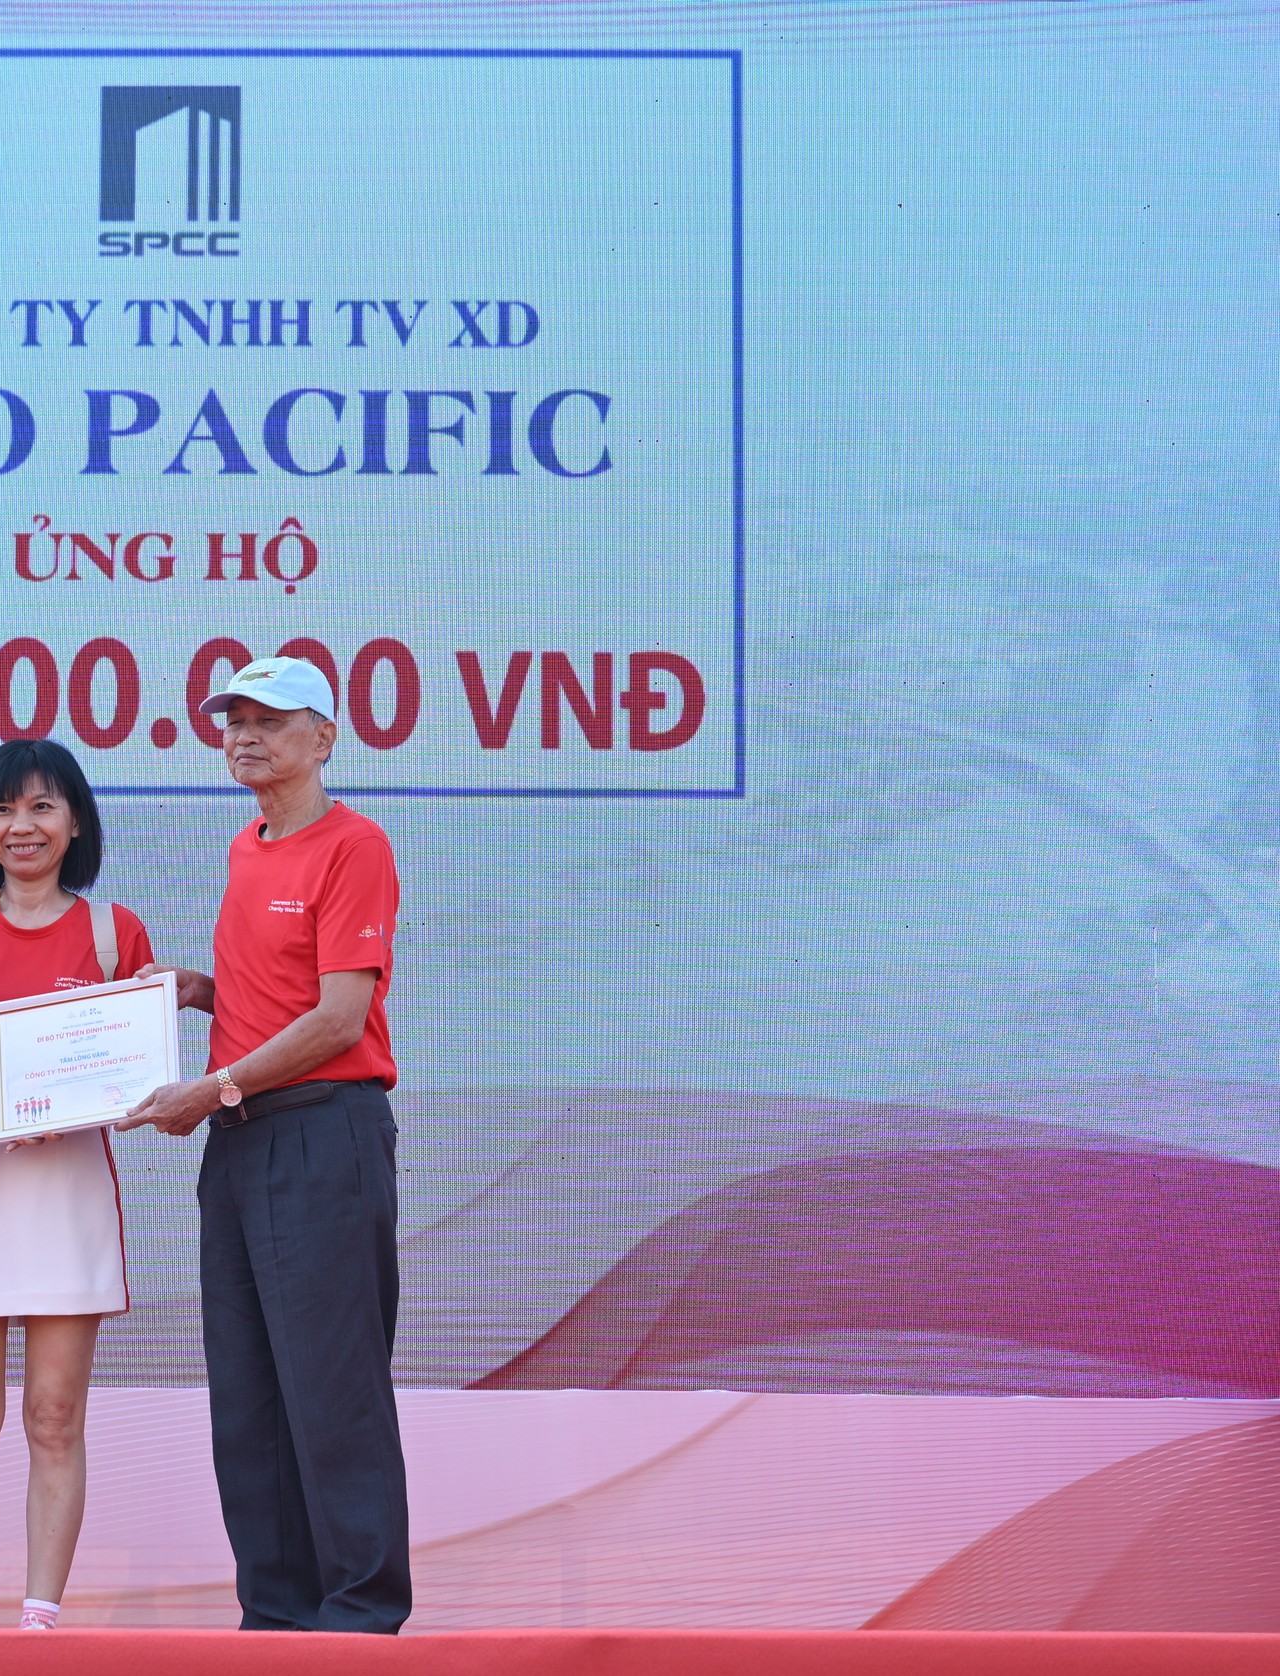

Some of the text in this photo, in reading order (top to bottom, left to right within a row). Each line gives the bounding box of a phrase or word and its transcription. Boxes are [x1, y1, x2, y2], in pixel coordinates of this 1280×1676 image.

[99, 232, 240, 257] SPCC
[10, 300, 101, 348] TY
[124, 300, 311, 348] TNHH
[335, 300, 429, 348] TV
[448, 300, 540, 349] XD
[80, 387, 613, 478] PACIFIC
[12, 515, 320, 595] ỦNG HỘ
[455, 651, 705, 752] VNĐ
[57, 1065, 78, 1075] TNHH
[79, 1063, 88, 1071] TV
[100, 1058, 118, 1067] SINO
[119, 1053, 147, 1063] PACIFIC
